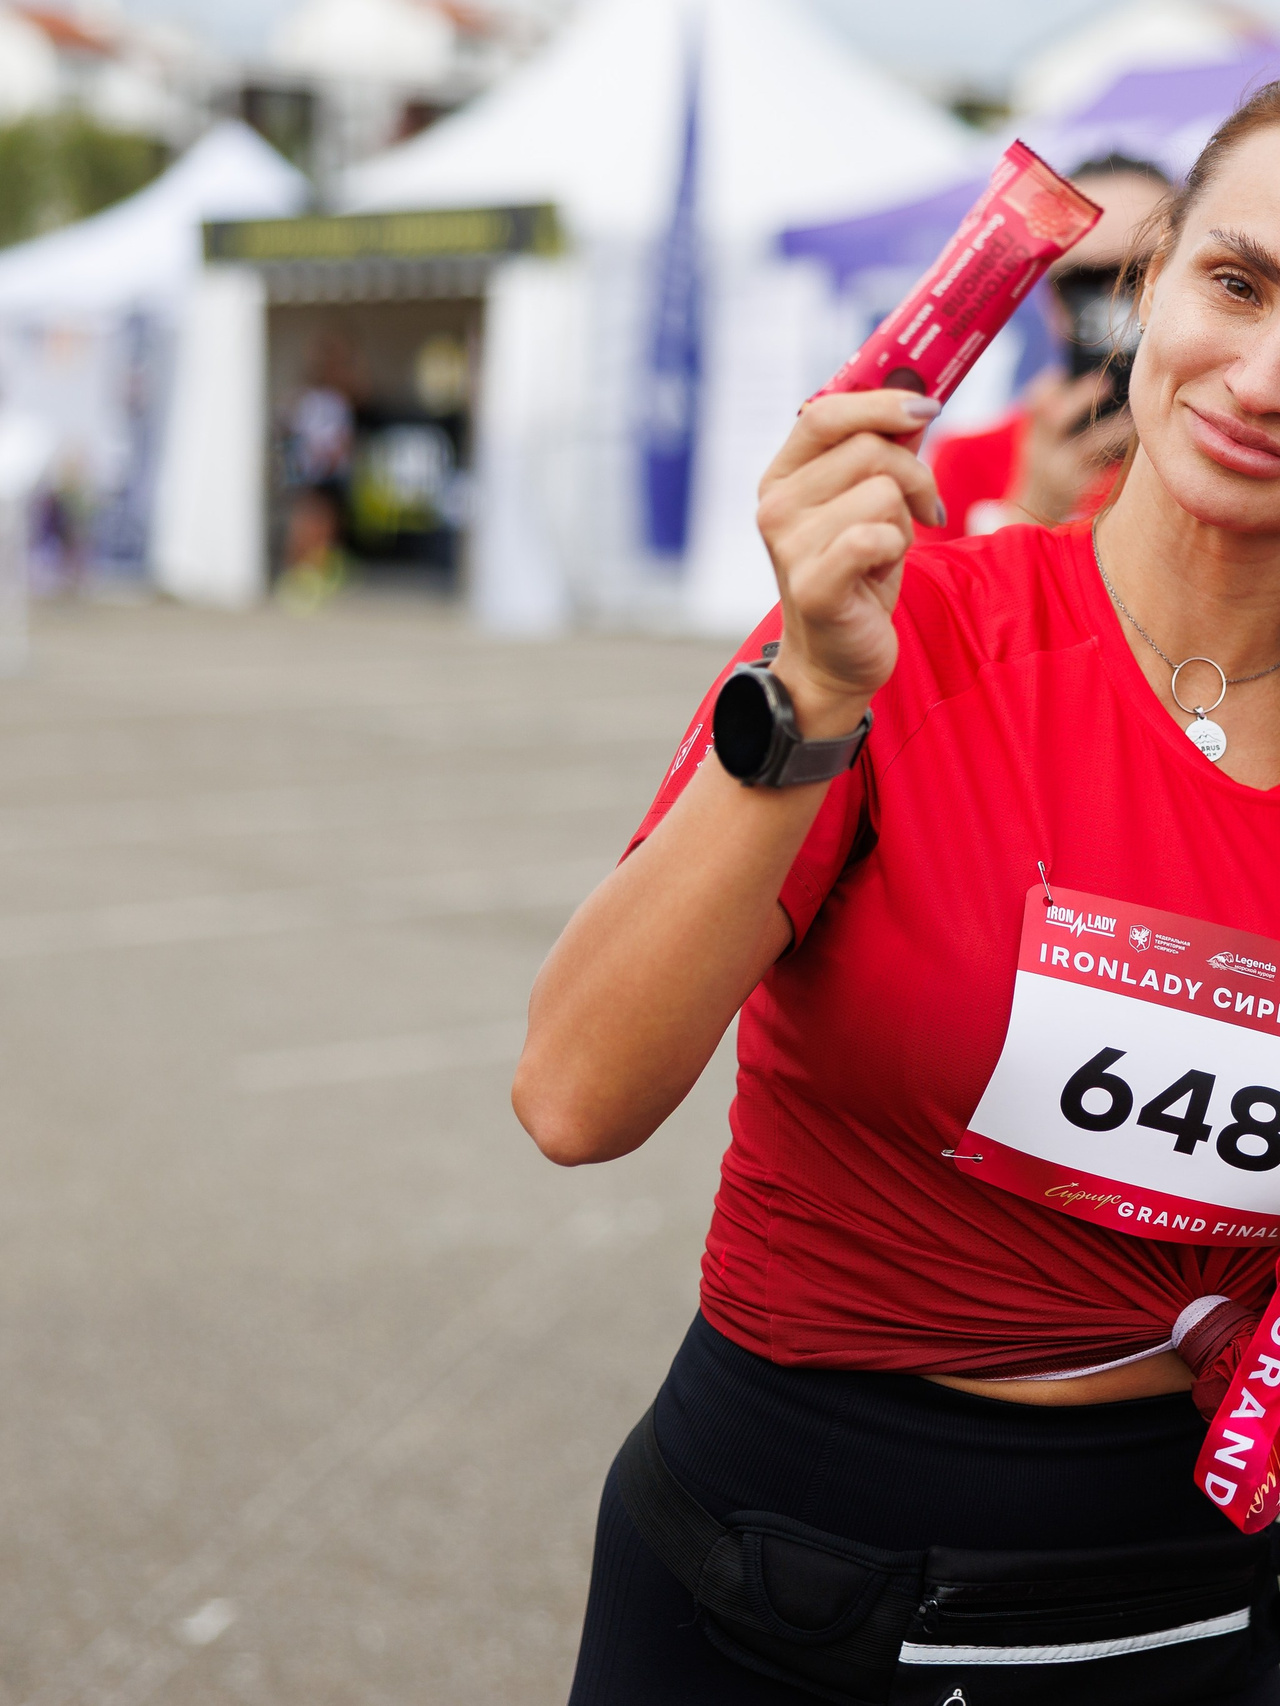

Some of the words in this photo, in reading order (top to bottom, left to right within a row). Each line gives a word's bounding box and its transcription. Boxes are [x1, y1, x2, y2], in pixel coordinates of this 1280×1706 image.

[1047, 905, 1074, 923] IRON
[1087, 913, 1117, 933] LADY
[1154, 939, 1186, 951] ТЕРРИТОРИЯ
[1155, 933, 1191, 947] ФЕДЕРАЛЬНАЯ
[1039, 943, 1203, 1001] IRONLADY
[1234, 964, 1257, 974] морской
[1257, 970, 1275, 979] курорт
[1235, 954, 1277, 973] Legenda
[1044, 1182, 1122, 1210] Сириус
[1117, 1200, 1207, 1233] GRAND
[1211, 1221, 1280, 1239] FINAL
